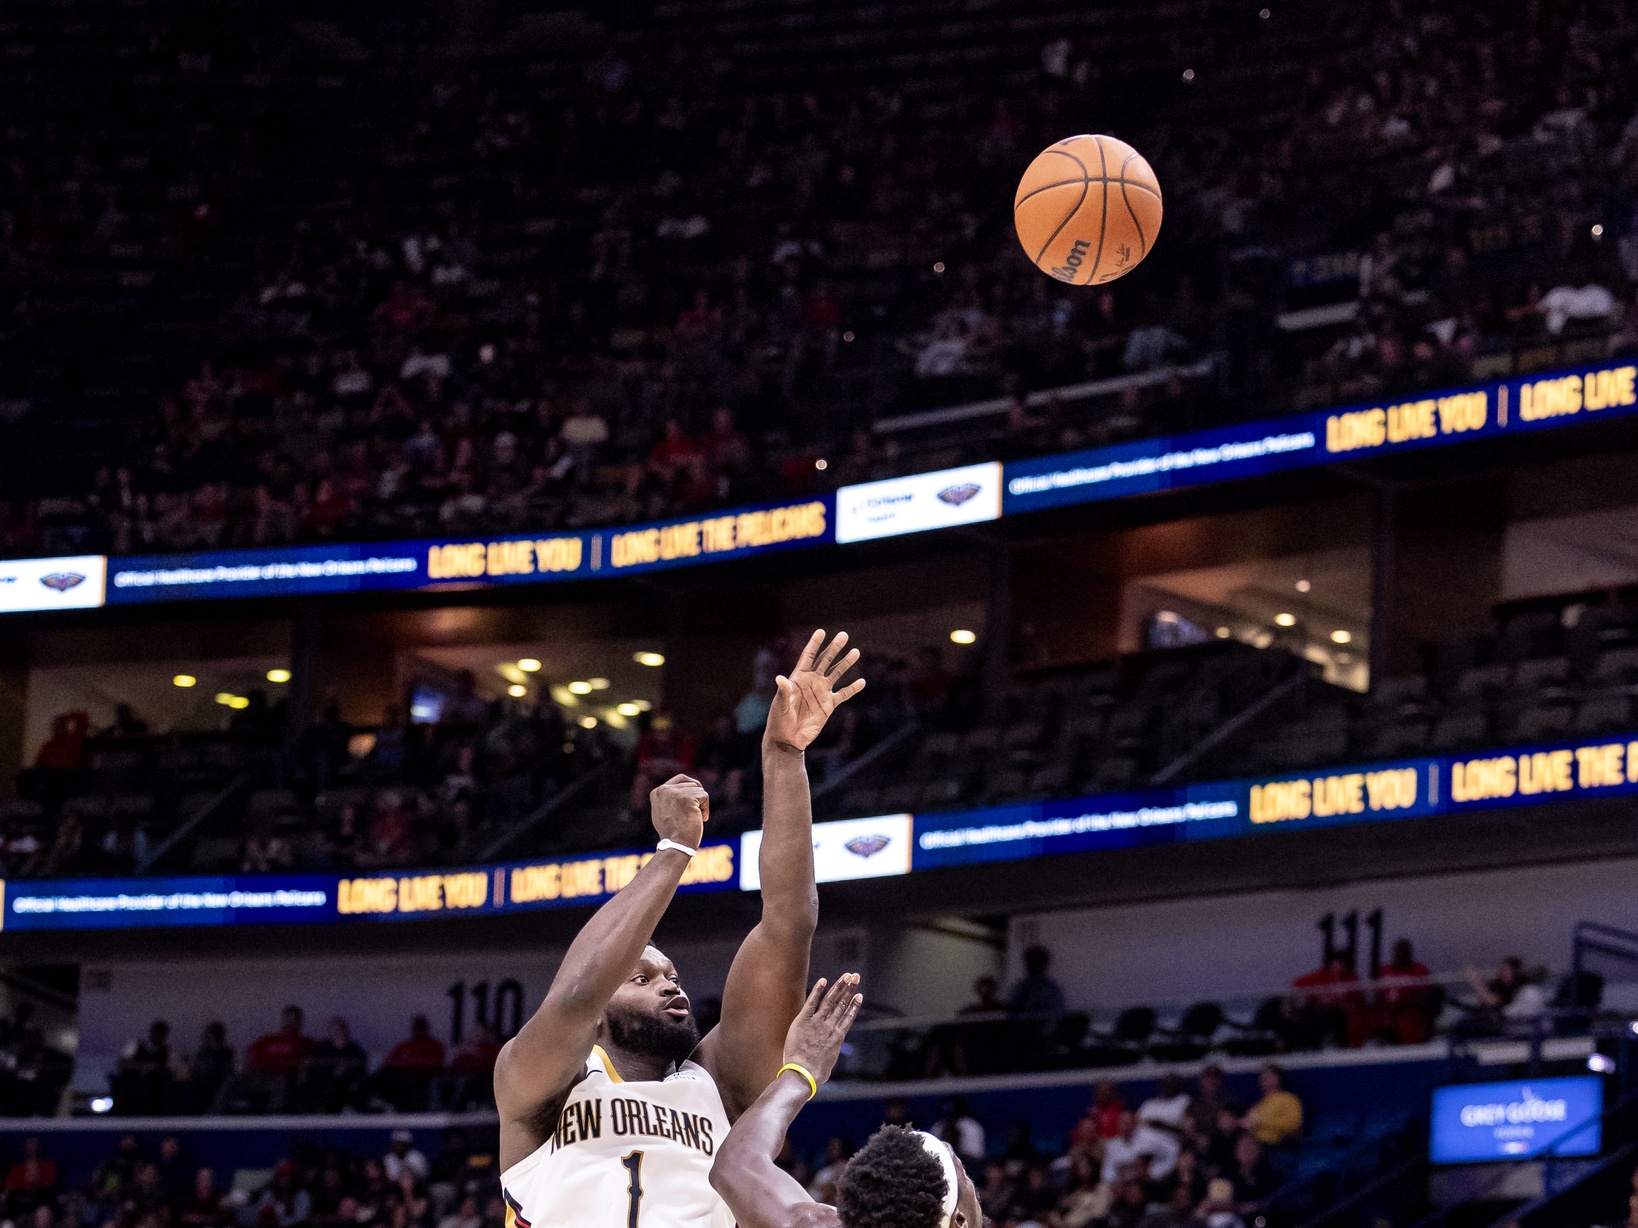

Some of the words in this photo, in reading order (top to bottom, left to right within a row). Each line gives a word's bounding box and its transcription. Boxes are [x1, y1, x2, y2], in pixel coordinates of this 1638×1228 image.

[1520, 376, 1582, 420] LONG
[1584, 367, 1636, 410] LIVE
[1327, 409, 1386, 452] LONG
[1387, 400, 1436, 442] LIVE
[1437, 392, 1487, 433] YOU
[428, 543, 485, 578] LONG
[486, 541, 534, 575] LIVE
[535, 538, 582, 571] YOU
[611, 529, 658, 567] LONG
[659, 523, 700, 559] LIVE
[702, 517, 735, 551] THE
[736, 502, 825, 546] PELICANS
[1250, 780, 1311, 823] LONG
[1313, 774, 1364, 816] LIVE
[1365, 769, 1416, 810] YOU
[1452, 757, 1516, 801] LONG
[1519, 750, 1573, 794] LIVE
[1576, 744, 1624, 787] THE
[338, 878, 397, 913] LONG
[398, 876, 442, 912] LIVE
[443, 873, 487, 908] YOU
[511, 864, 560, 902] LONG
[561, 860, 602, 897] LIVE
[604, 854, 640, 892] THE
[448, 978, 522, 1043] 110
[550, 1098, 602, 1157] NEW
[610, 1097, 714, 1157] ORLEANS
